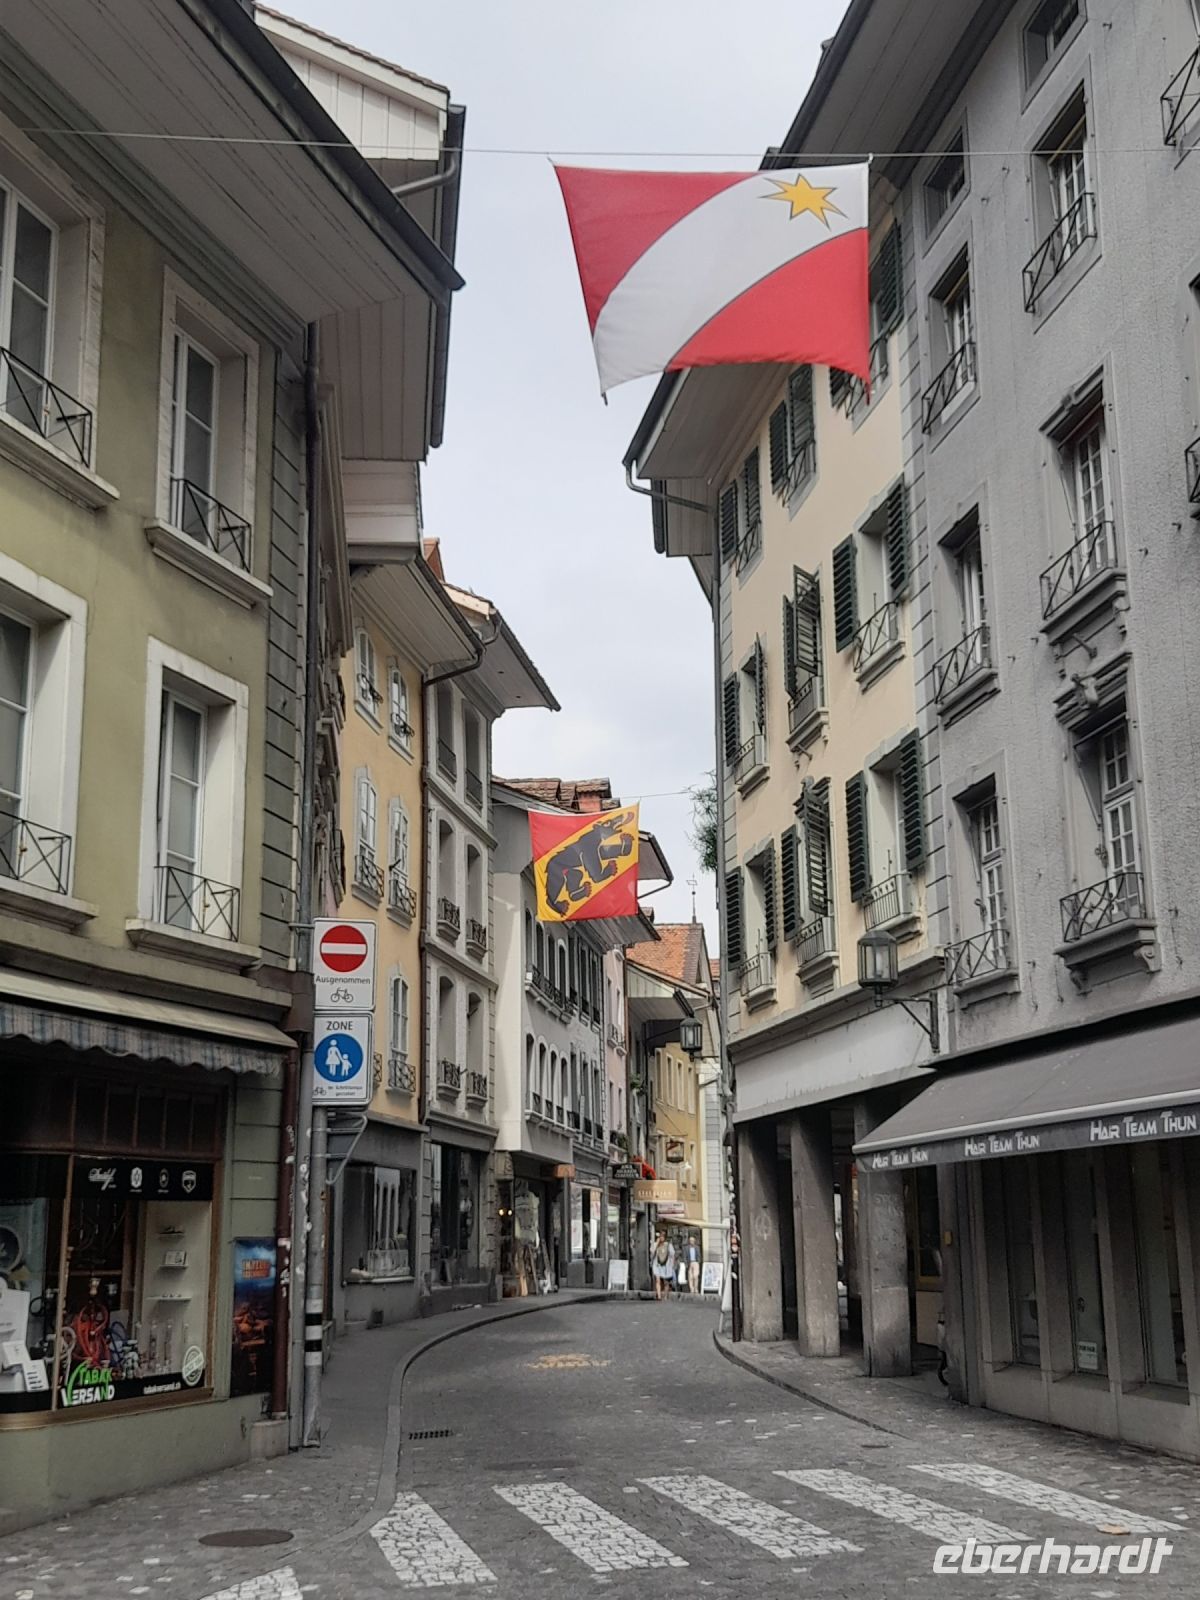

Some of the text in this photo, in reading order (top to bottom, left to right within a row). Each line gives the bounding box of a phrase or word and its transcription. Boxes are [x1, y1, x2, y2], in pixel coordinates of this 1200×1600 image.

[316, 975, 371, 985] Ausgenommen
[326, 1020, 353, 1031] ZONE
[1089, 1110, 1197, 1142] HAIR TEAM THUN
[988, 1134, 1013, 1154] TEAM
[1014, 1131, 1041, 1150] THUN
[78, 1366, 113, 1385] TABAK
[61, 1384, 115, 1406] VERSAND
